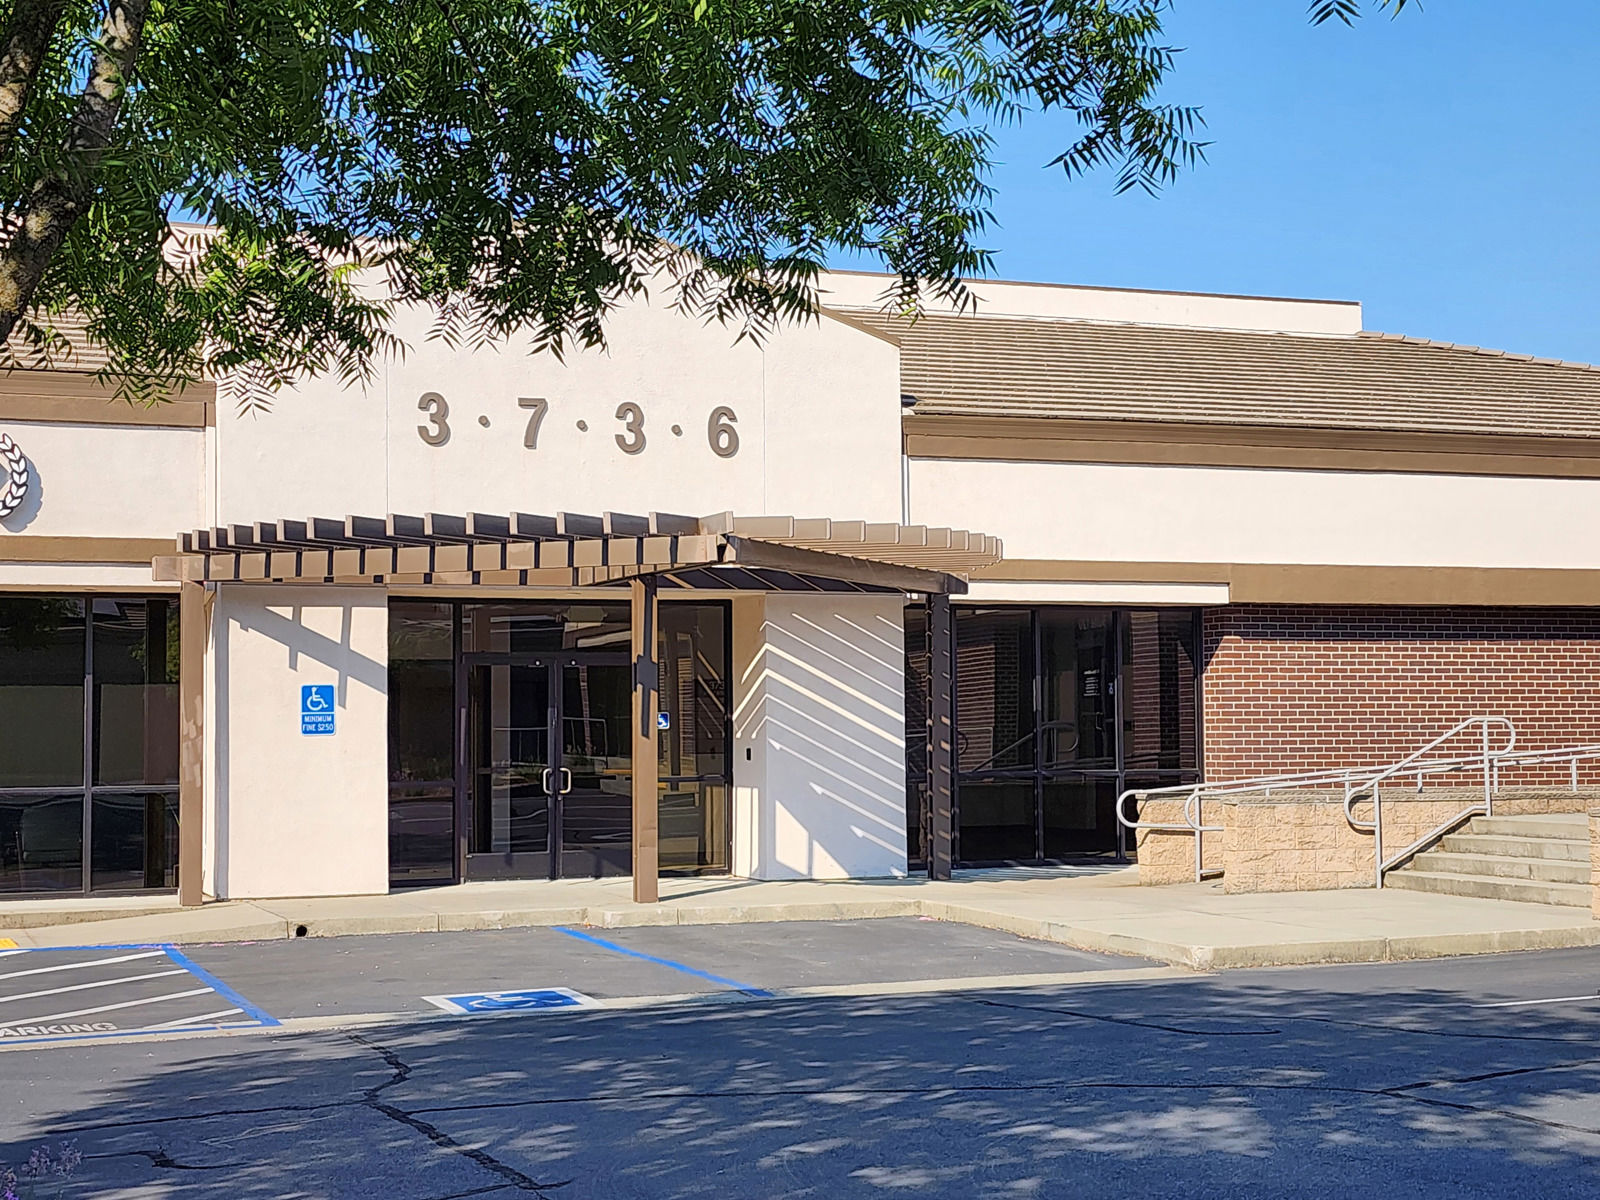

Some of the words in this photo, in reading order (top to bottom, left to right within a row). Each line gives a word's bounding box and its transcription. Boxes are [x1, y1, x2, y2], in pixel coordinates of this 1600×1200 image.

[304, 715, 332, 723] MINIMUM
[302, 723, 316, 731] FINE
[317, 723, 334, 731] $250
